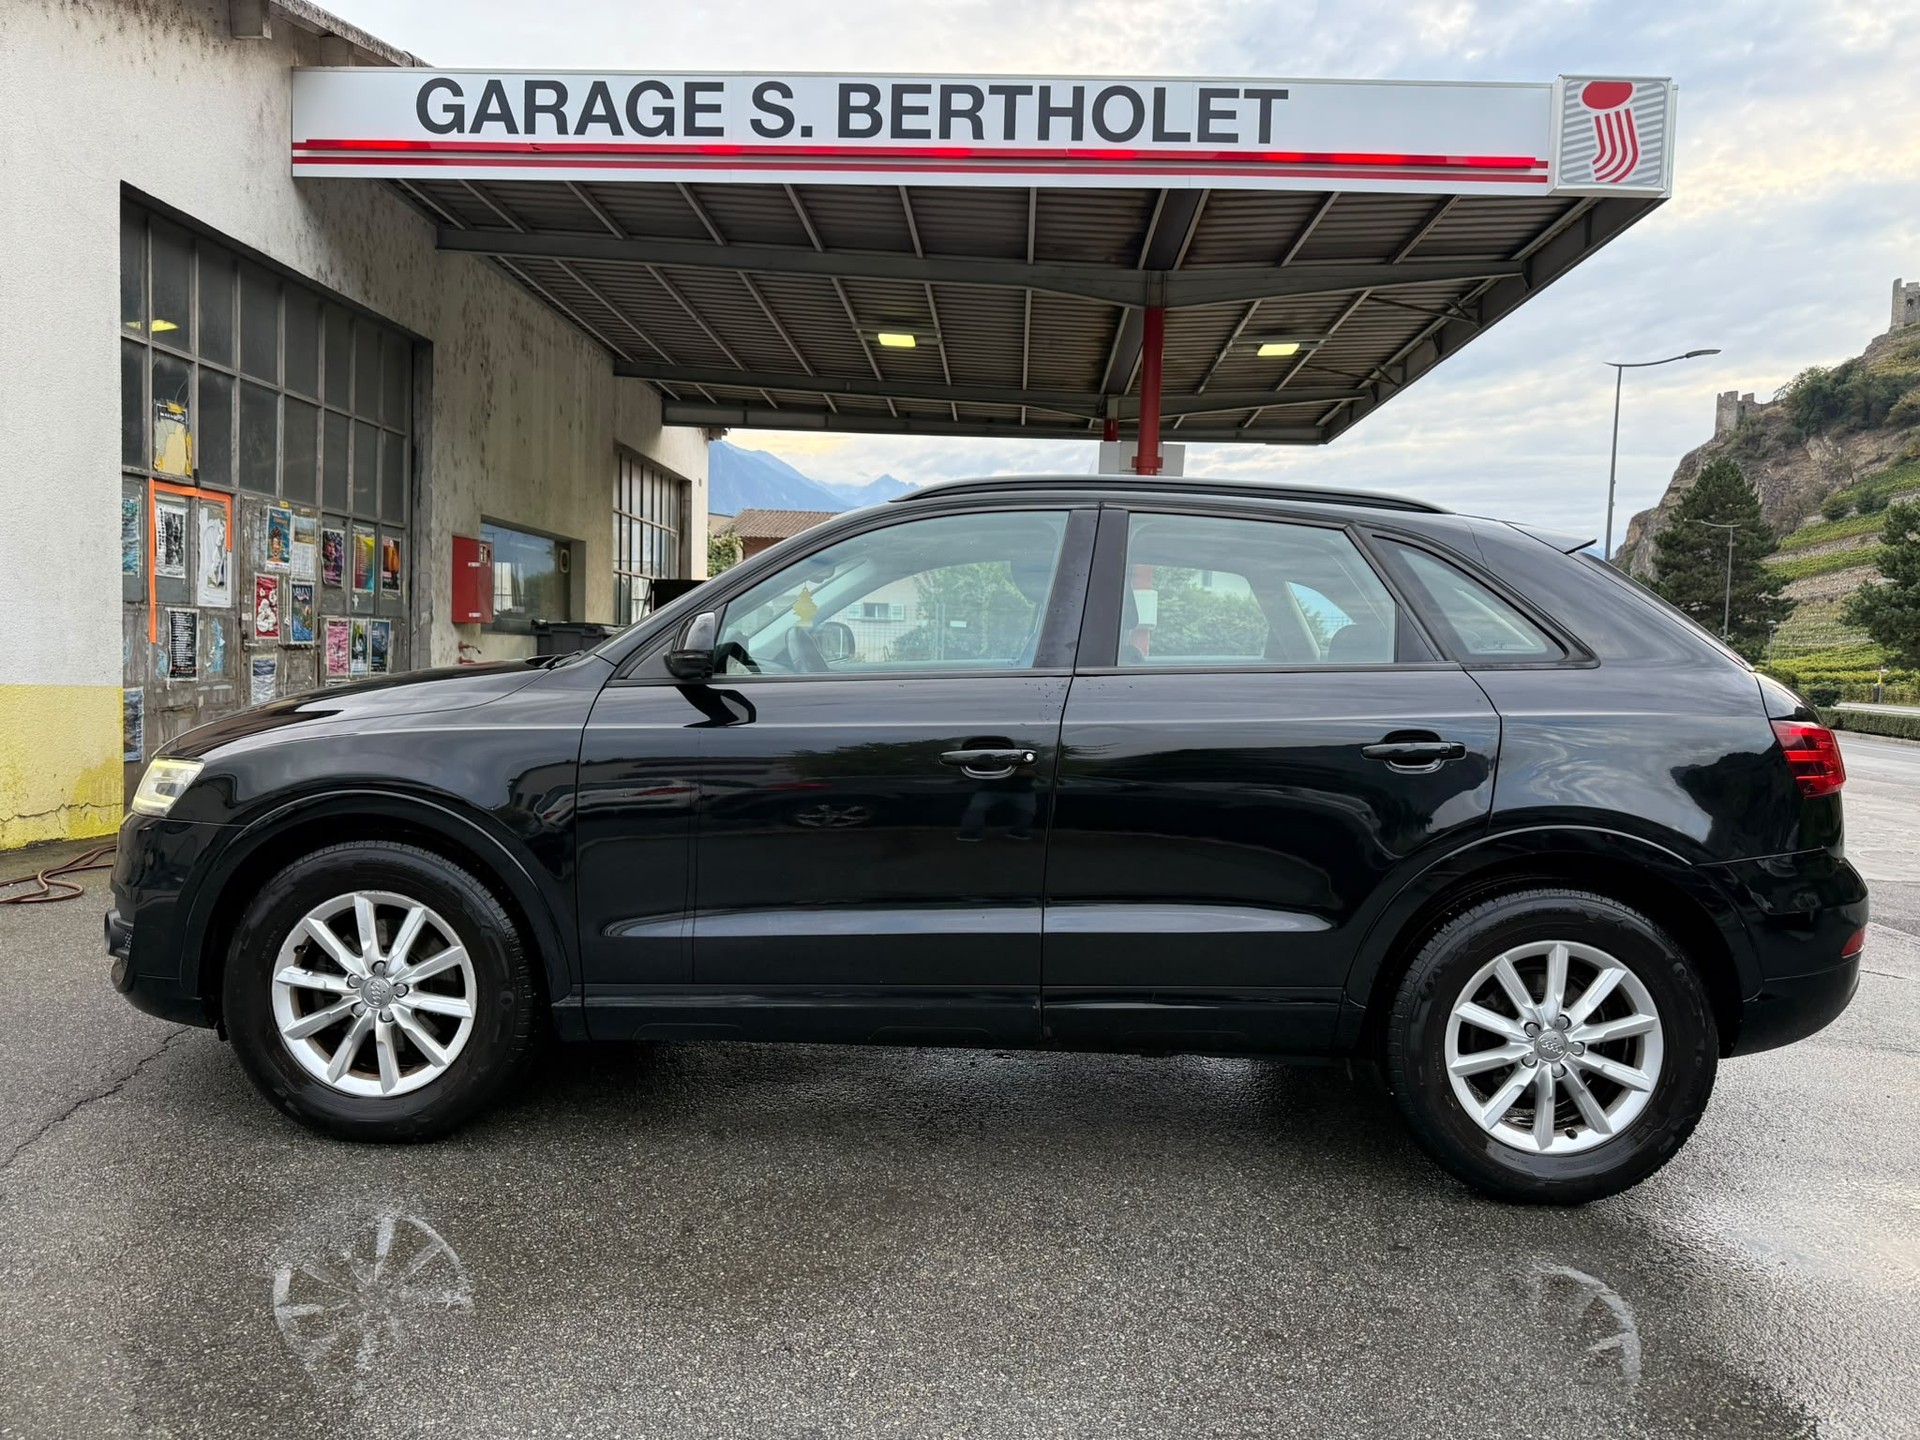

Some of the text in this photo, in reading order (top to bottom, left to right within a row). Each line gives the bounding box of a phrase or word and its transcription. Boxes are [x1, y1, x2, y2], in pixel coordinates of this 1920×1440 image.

[416, 77, 1289, 144] GARAGE S. BERTHOLET
